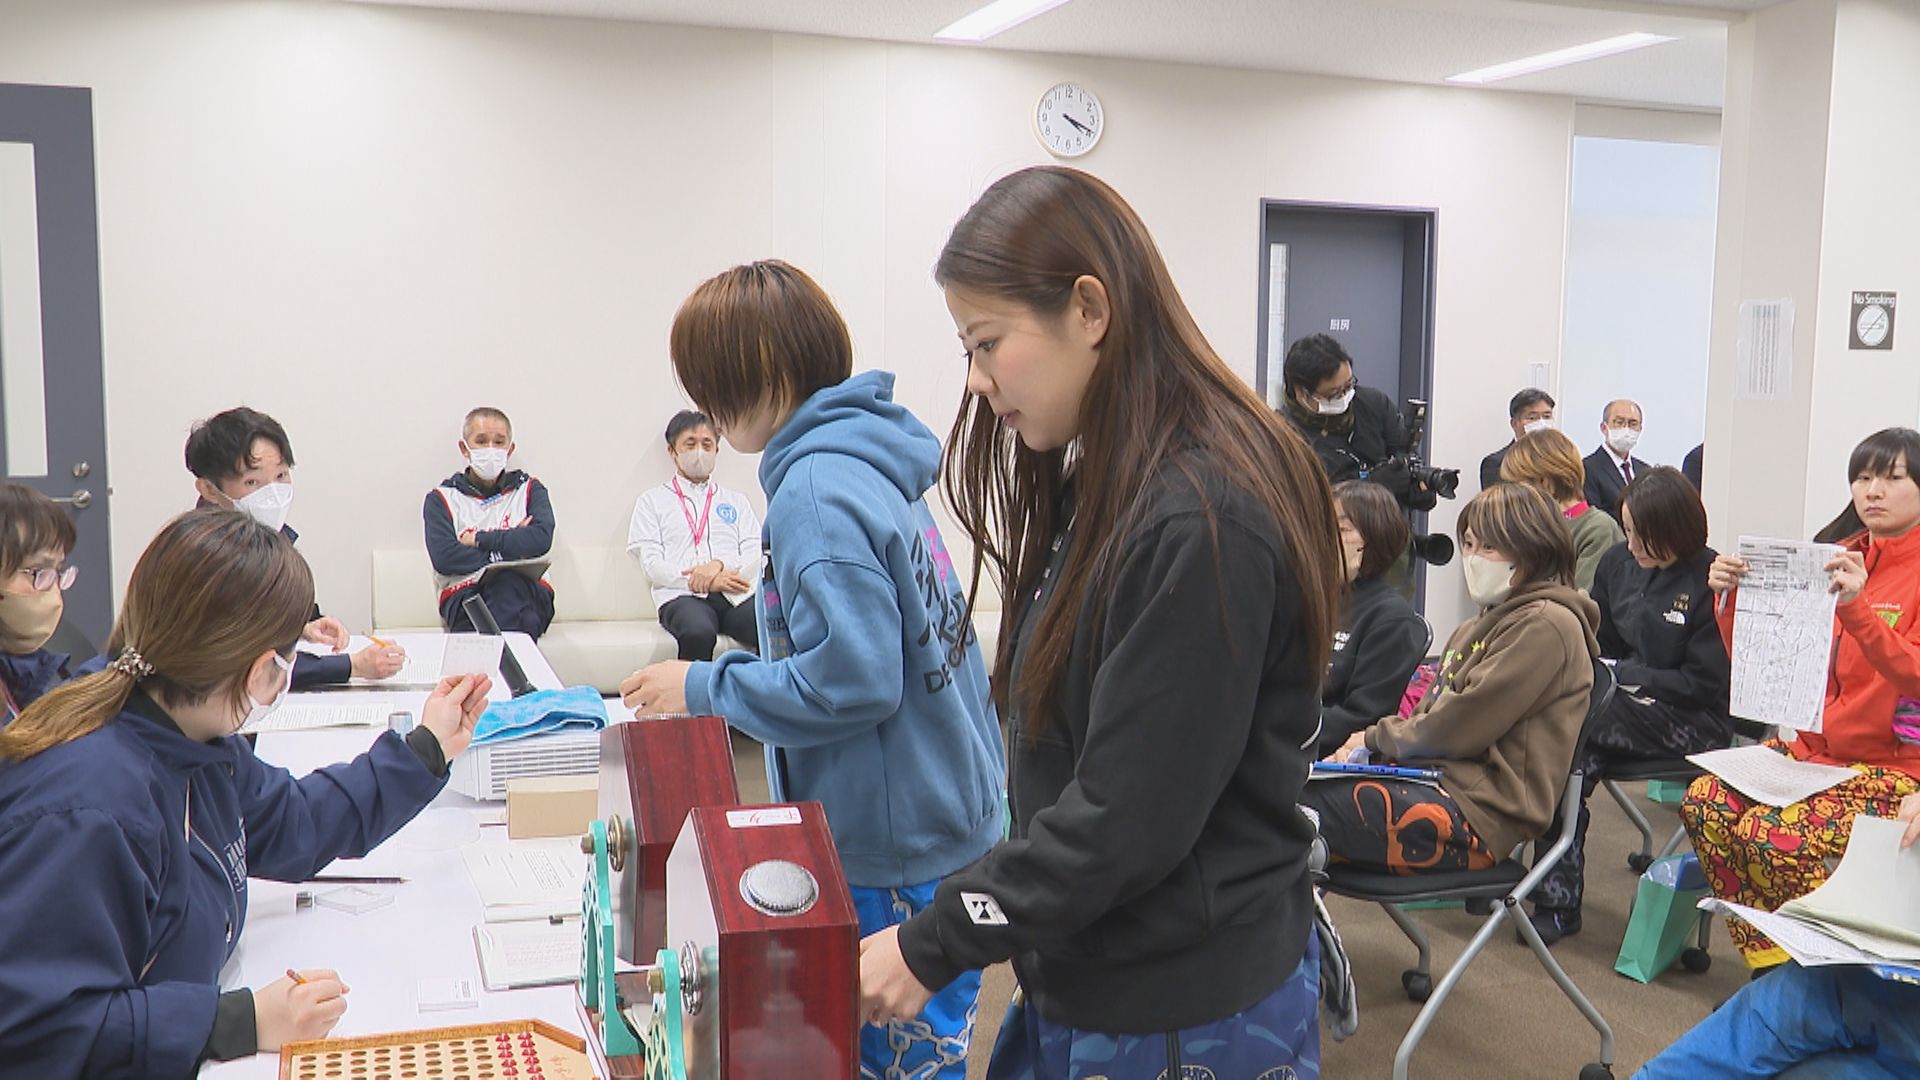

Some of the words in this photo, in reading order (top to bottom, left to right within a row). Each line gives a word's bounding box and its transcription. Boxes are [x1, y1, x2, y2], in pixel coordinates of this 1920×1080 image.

[1054, 91, 1061, 100] 11
[1065, 88, 1073, 98] 12
[1079, 93, 1083, 102] 1
[1044, 100, 1053, 110] 10
[1086, 103, 1092, 112] 2
[1042, 112, 1048, 122] 9
[1089, 115, 1095, 125] 3
[1045, 126, 1051, 135] 8
[1055, 136, 1061, 145] 7
[1065, 139, 1071, 149] 6
[1076, 137, 1082, 146] 5
[1854, 293, 1864, 304] No
[1865, 293, 1896, 308] Smoking
